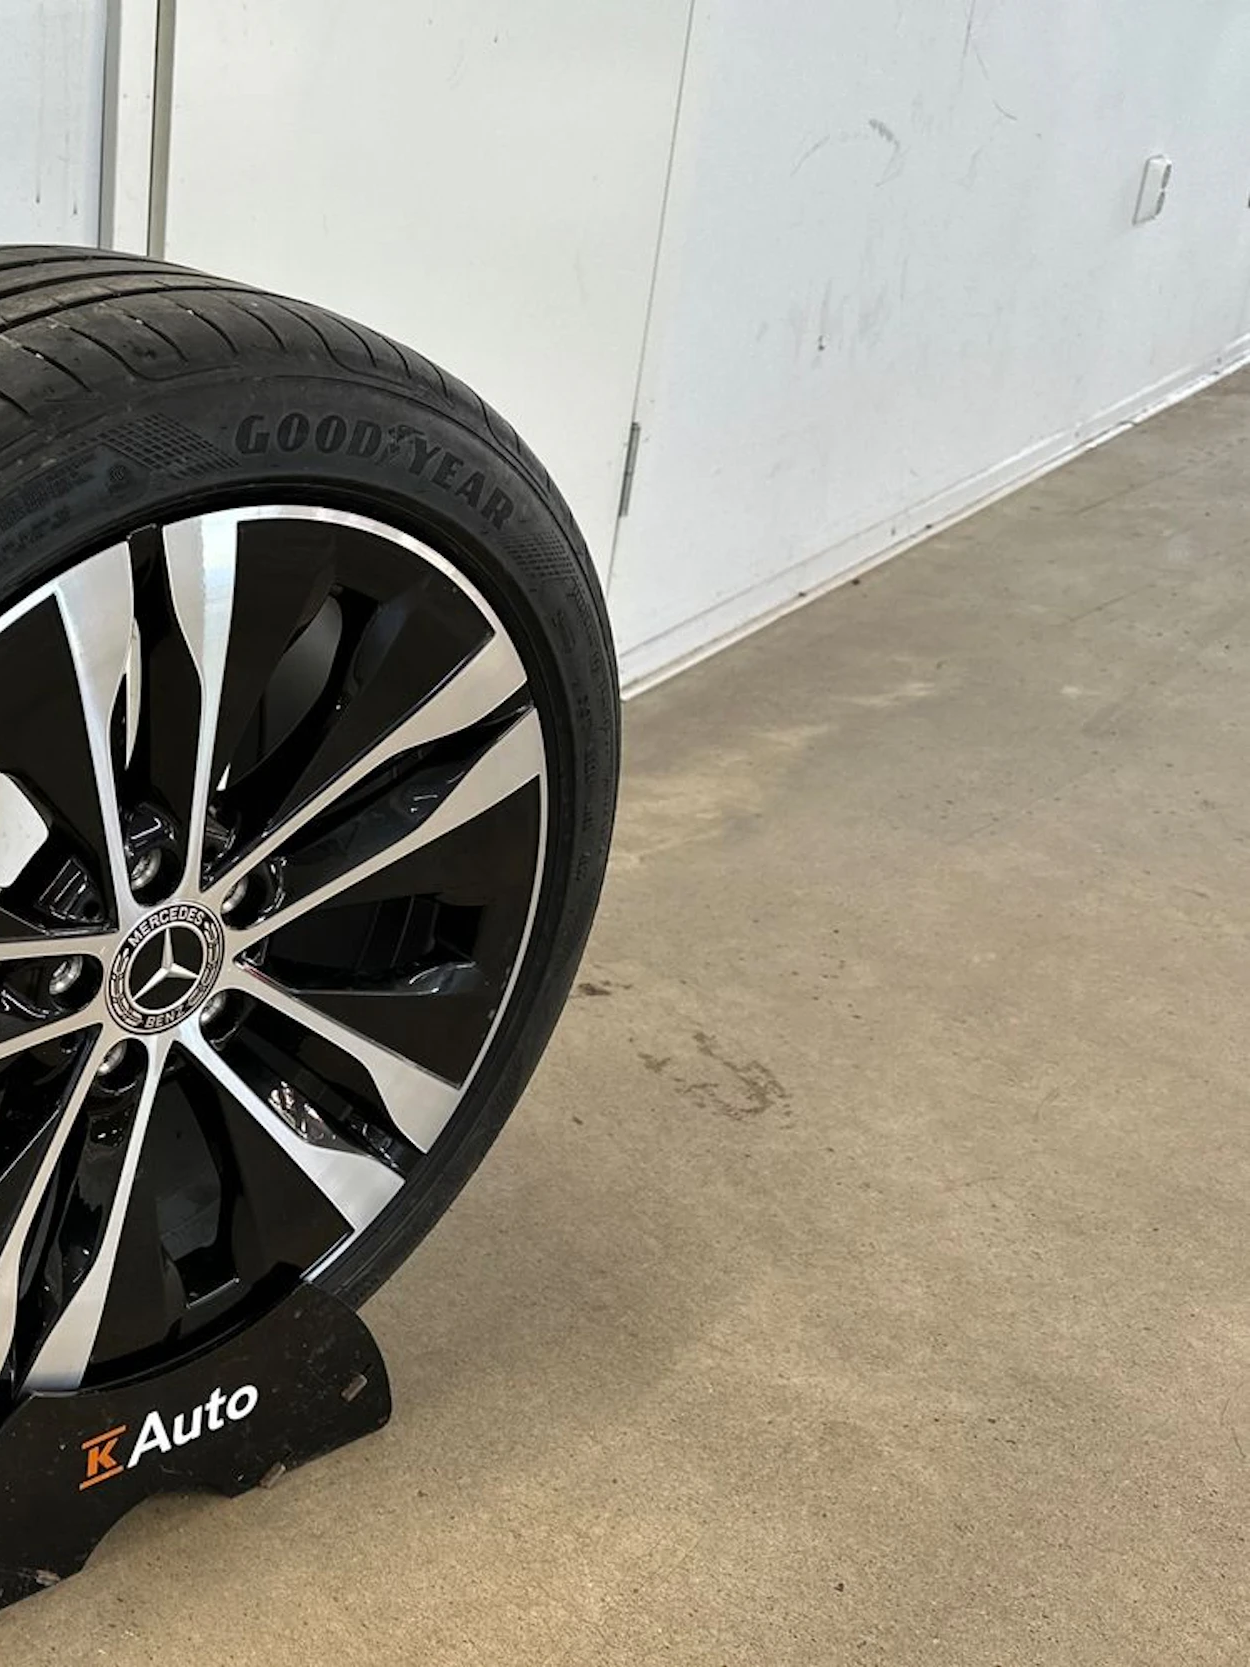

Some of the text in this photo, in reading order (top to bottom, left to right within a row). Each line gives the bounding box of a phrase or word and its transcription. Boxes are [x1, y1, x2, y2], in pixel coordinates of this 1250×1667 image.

[236, 412, 516, 530] GOODYEAR
[129, 906, 205, 947] MERCEDES
[145, 1008, 186, 1029] BENZ
